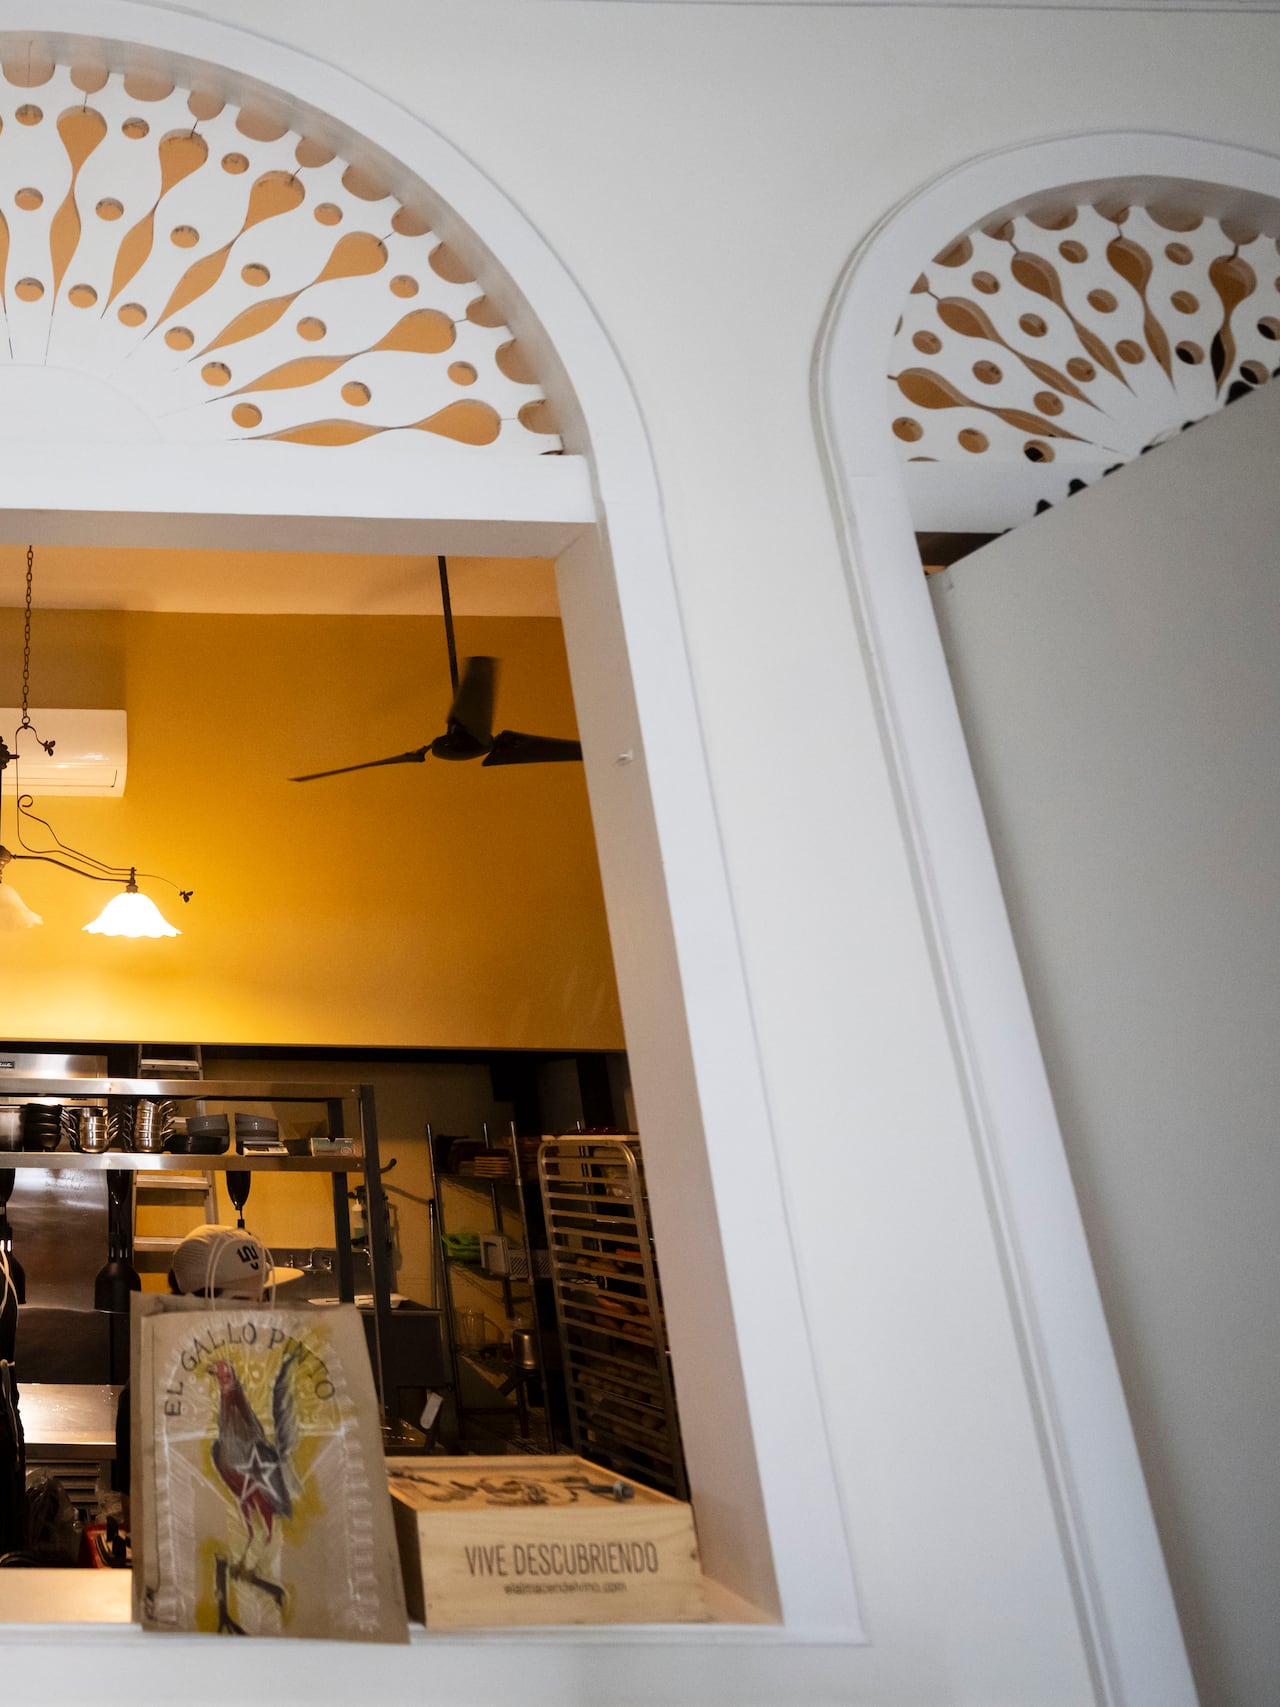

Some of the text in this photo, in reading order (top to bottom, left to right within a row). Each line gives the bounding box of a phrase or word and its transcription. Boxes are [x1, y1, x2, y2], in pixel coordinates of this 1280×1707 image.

[164, 1322, 336, 1417] EL GALLO PINTO
[464, 1541, 659, 1577] VIVE DESCUBRIENDO
